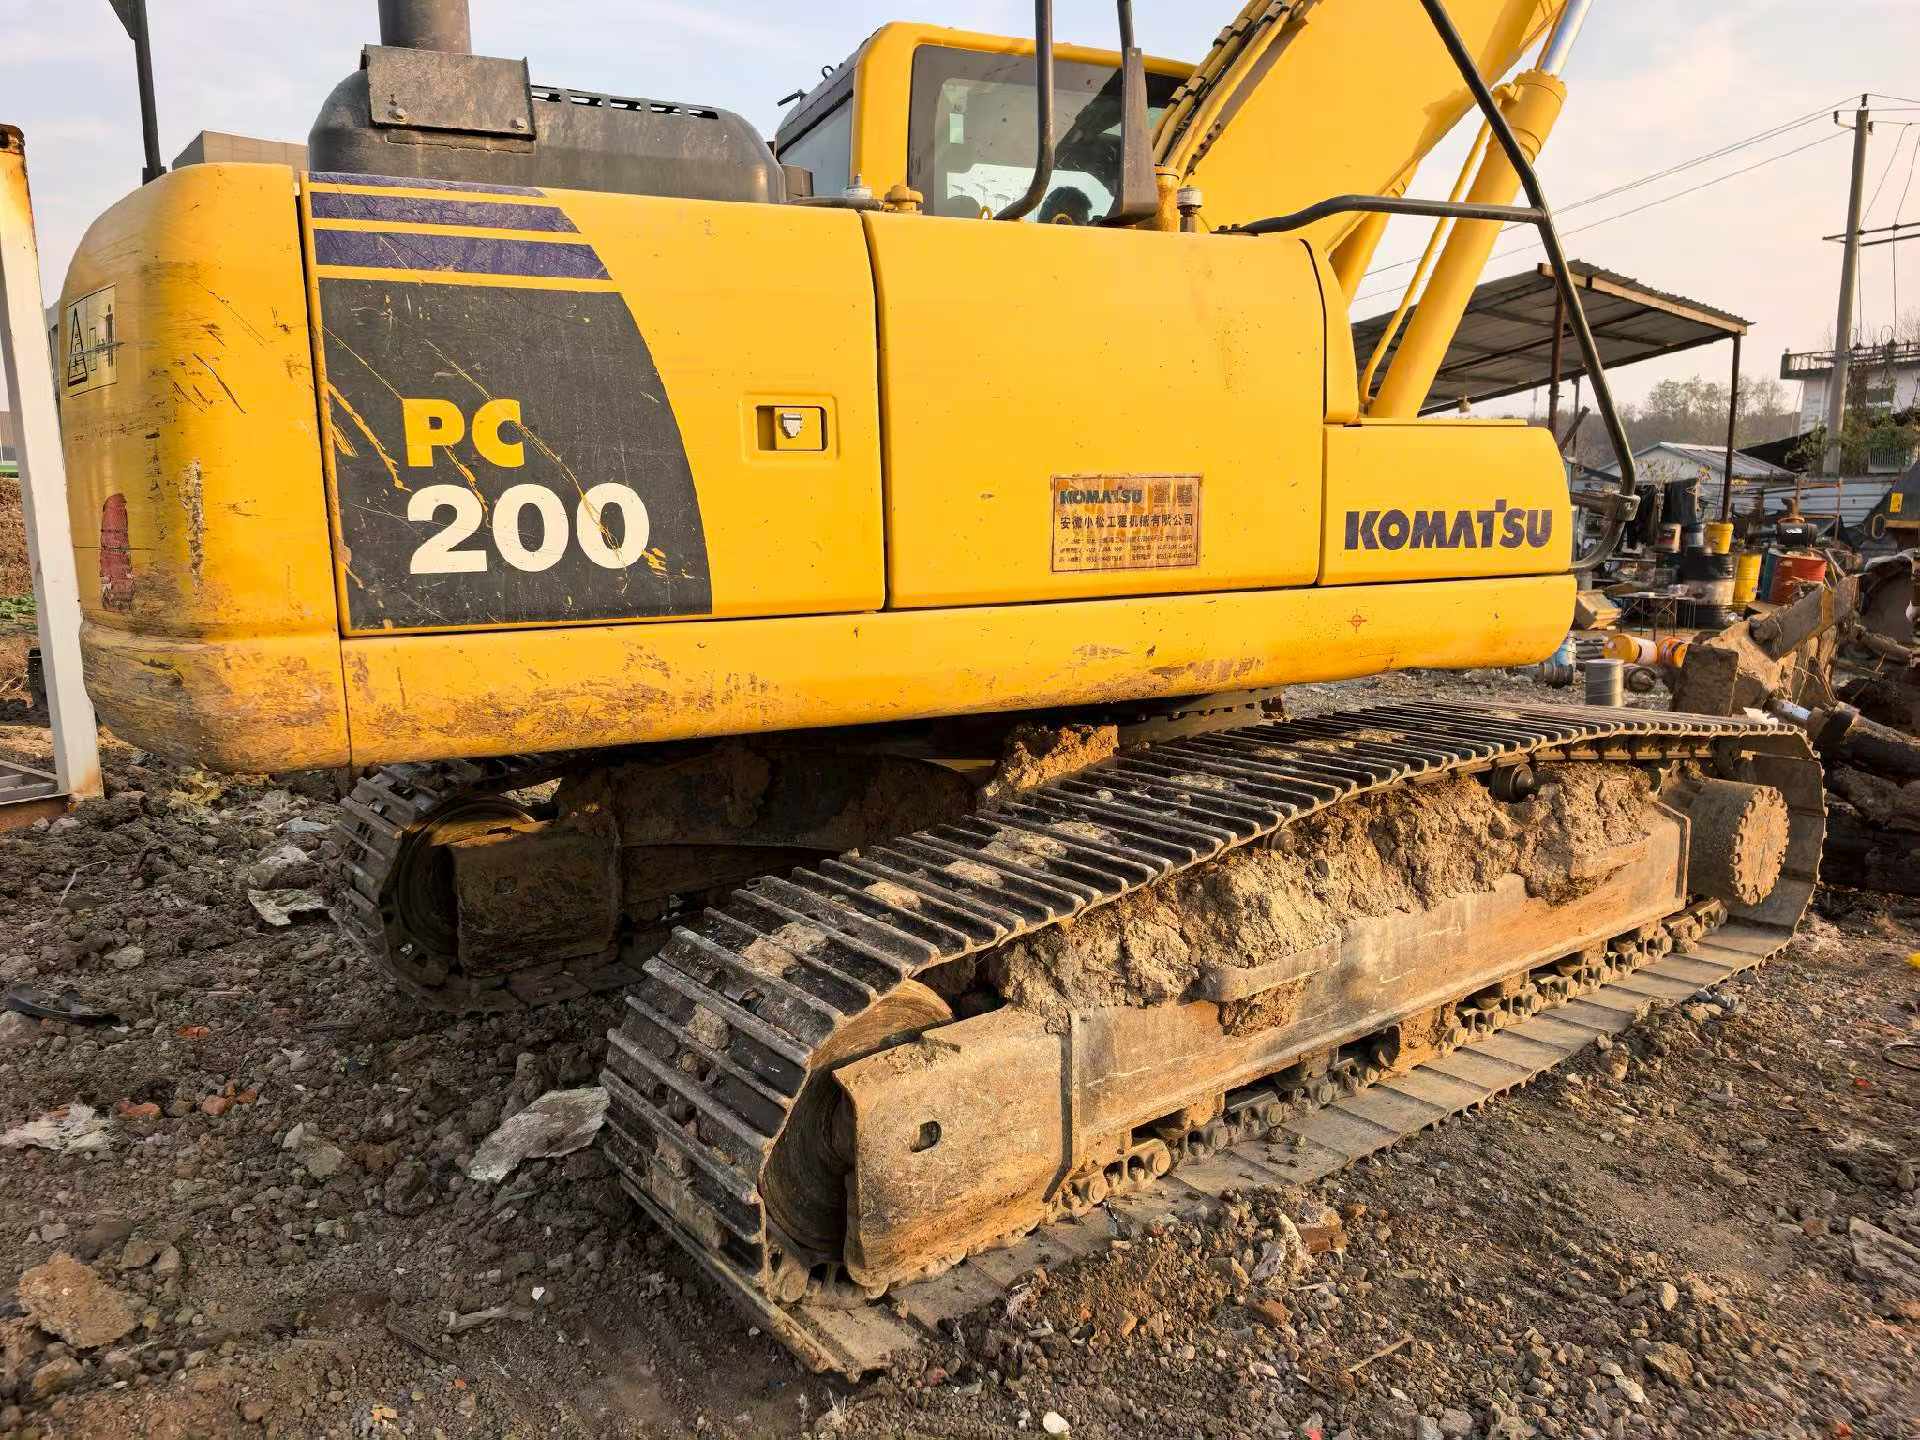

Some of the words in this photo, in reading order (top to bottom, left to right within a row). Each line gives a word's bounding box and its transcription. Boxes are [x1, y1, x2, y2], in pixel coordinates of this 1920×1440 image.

[402, 398, 525, 468] PC
[1059, 486, 1142, 505] KOMATSU
[407, 482, 650, 575] 200
[1060, 513, 1193, 530] 安徽小松工程机械有限公司
[1344, 499, 1553, 550] KOMATSU
